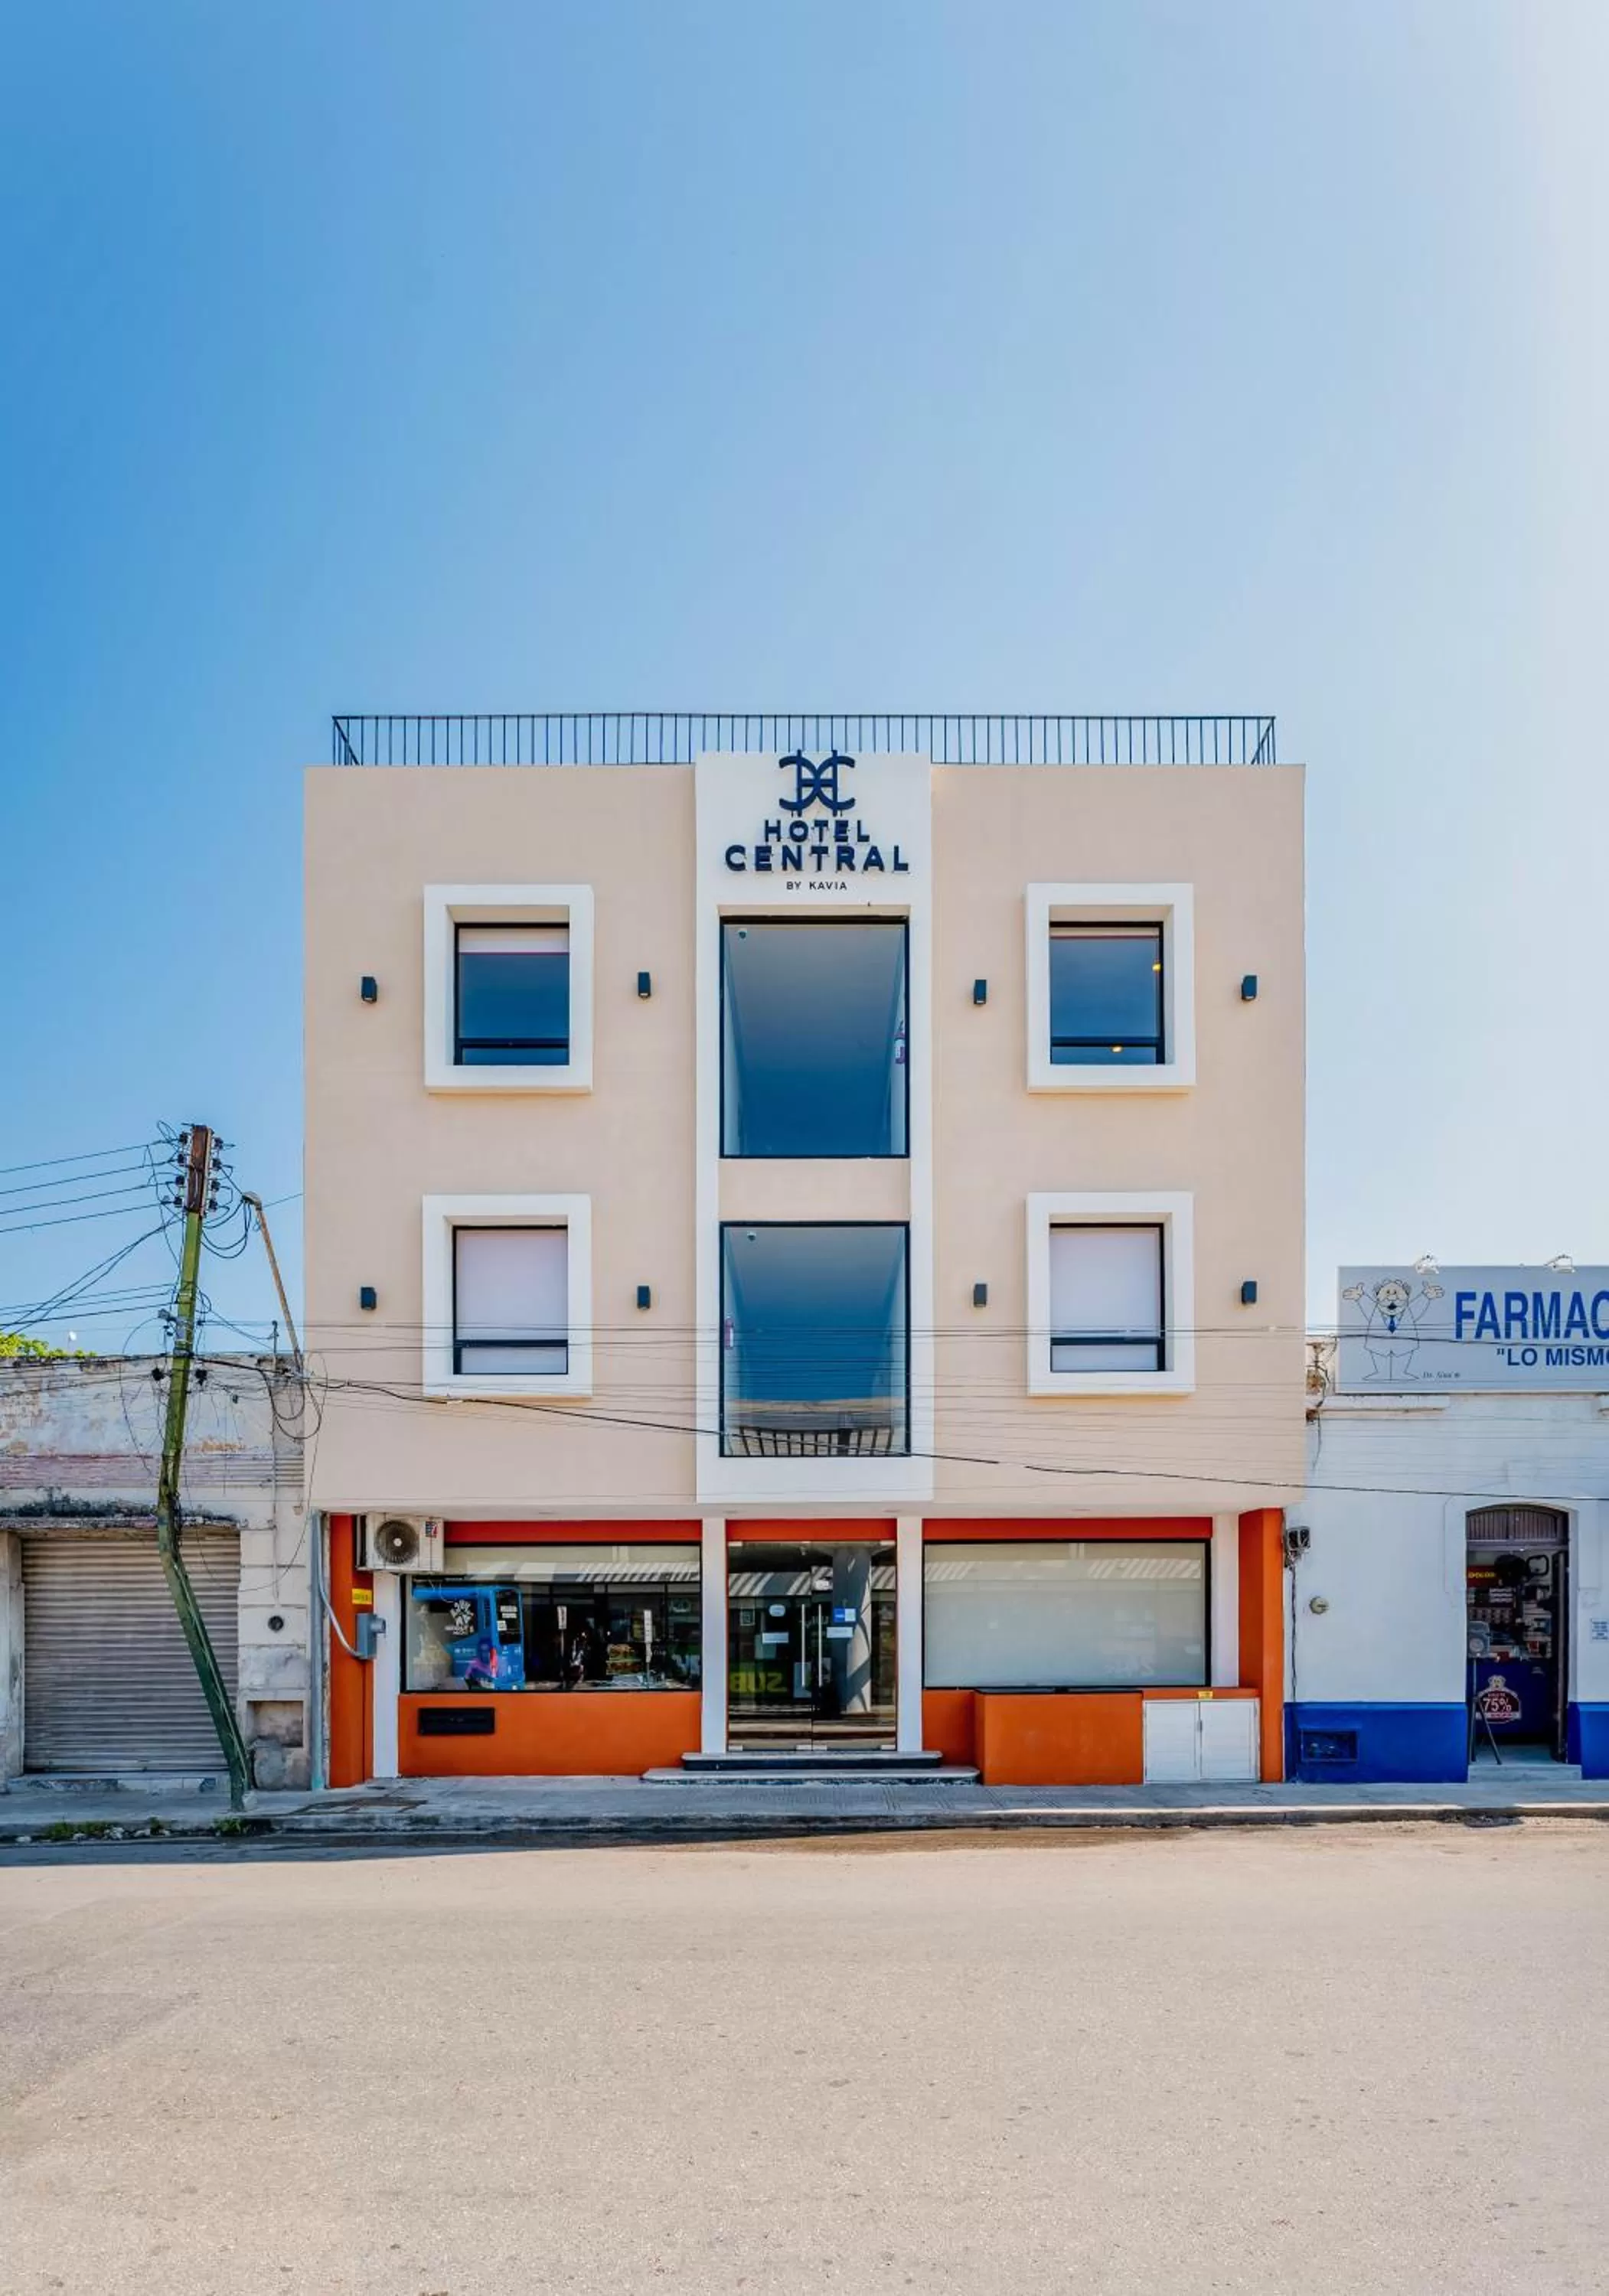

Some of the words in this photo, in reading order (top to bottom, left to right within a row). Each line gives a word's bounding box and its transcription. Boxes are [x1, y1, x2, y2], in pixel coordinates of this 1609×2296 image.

[765, 820, 870, 843] HOTEL
[725, 845, 909, 872] CENTRAL
[786, 881, 801, 890] BY
[809, 881, 847, 890] KAVIA
[1455, 1290, 1609, 1339] FARMAC
[1545, 1347, 1609, 1366] MISM
[1482, 1697, 1512, 1713] 75%
